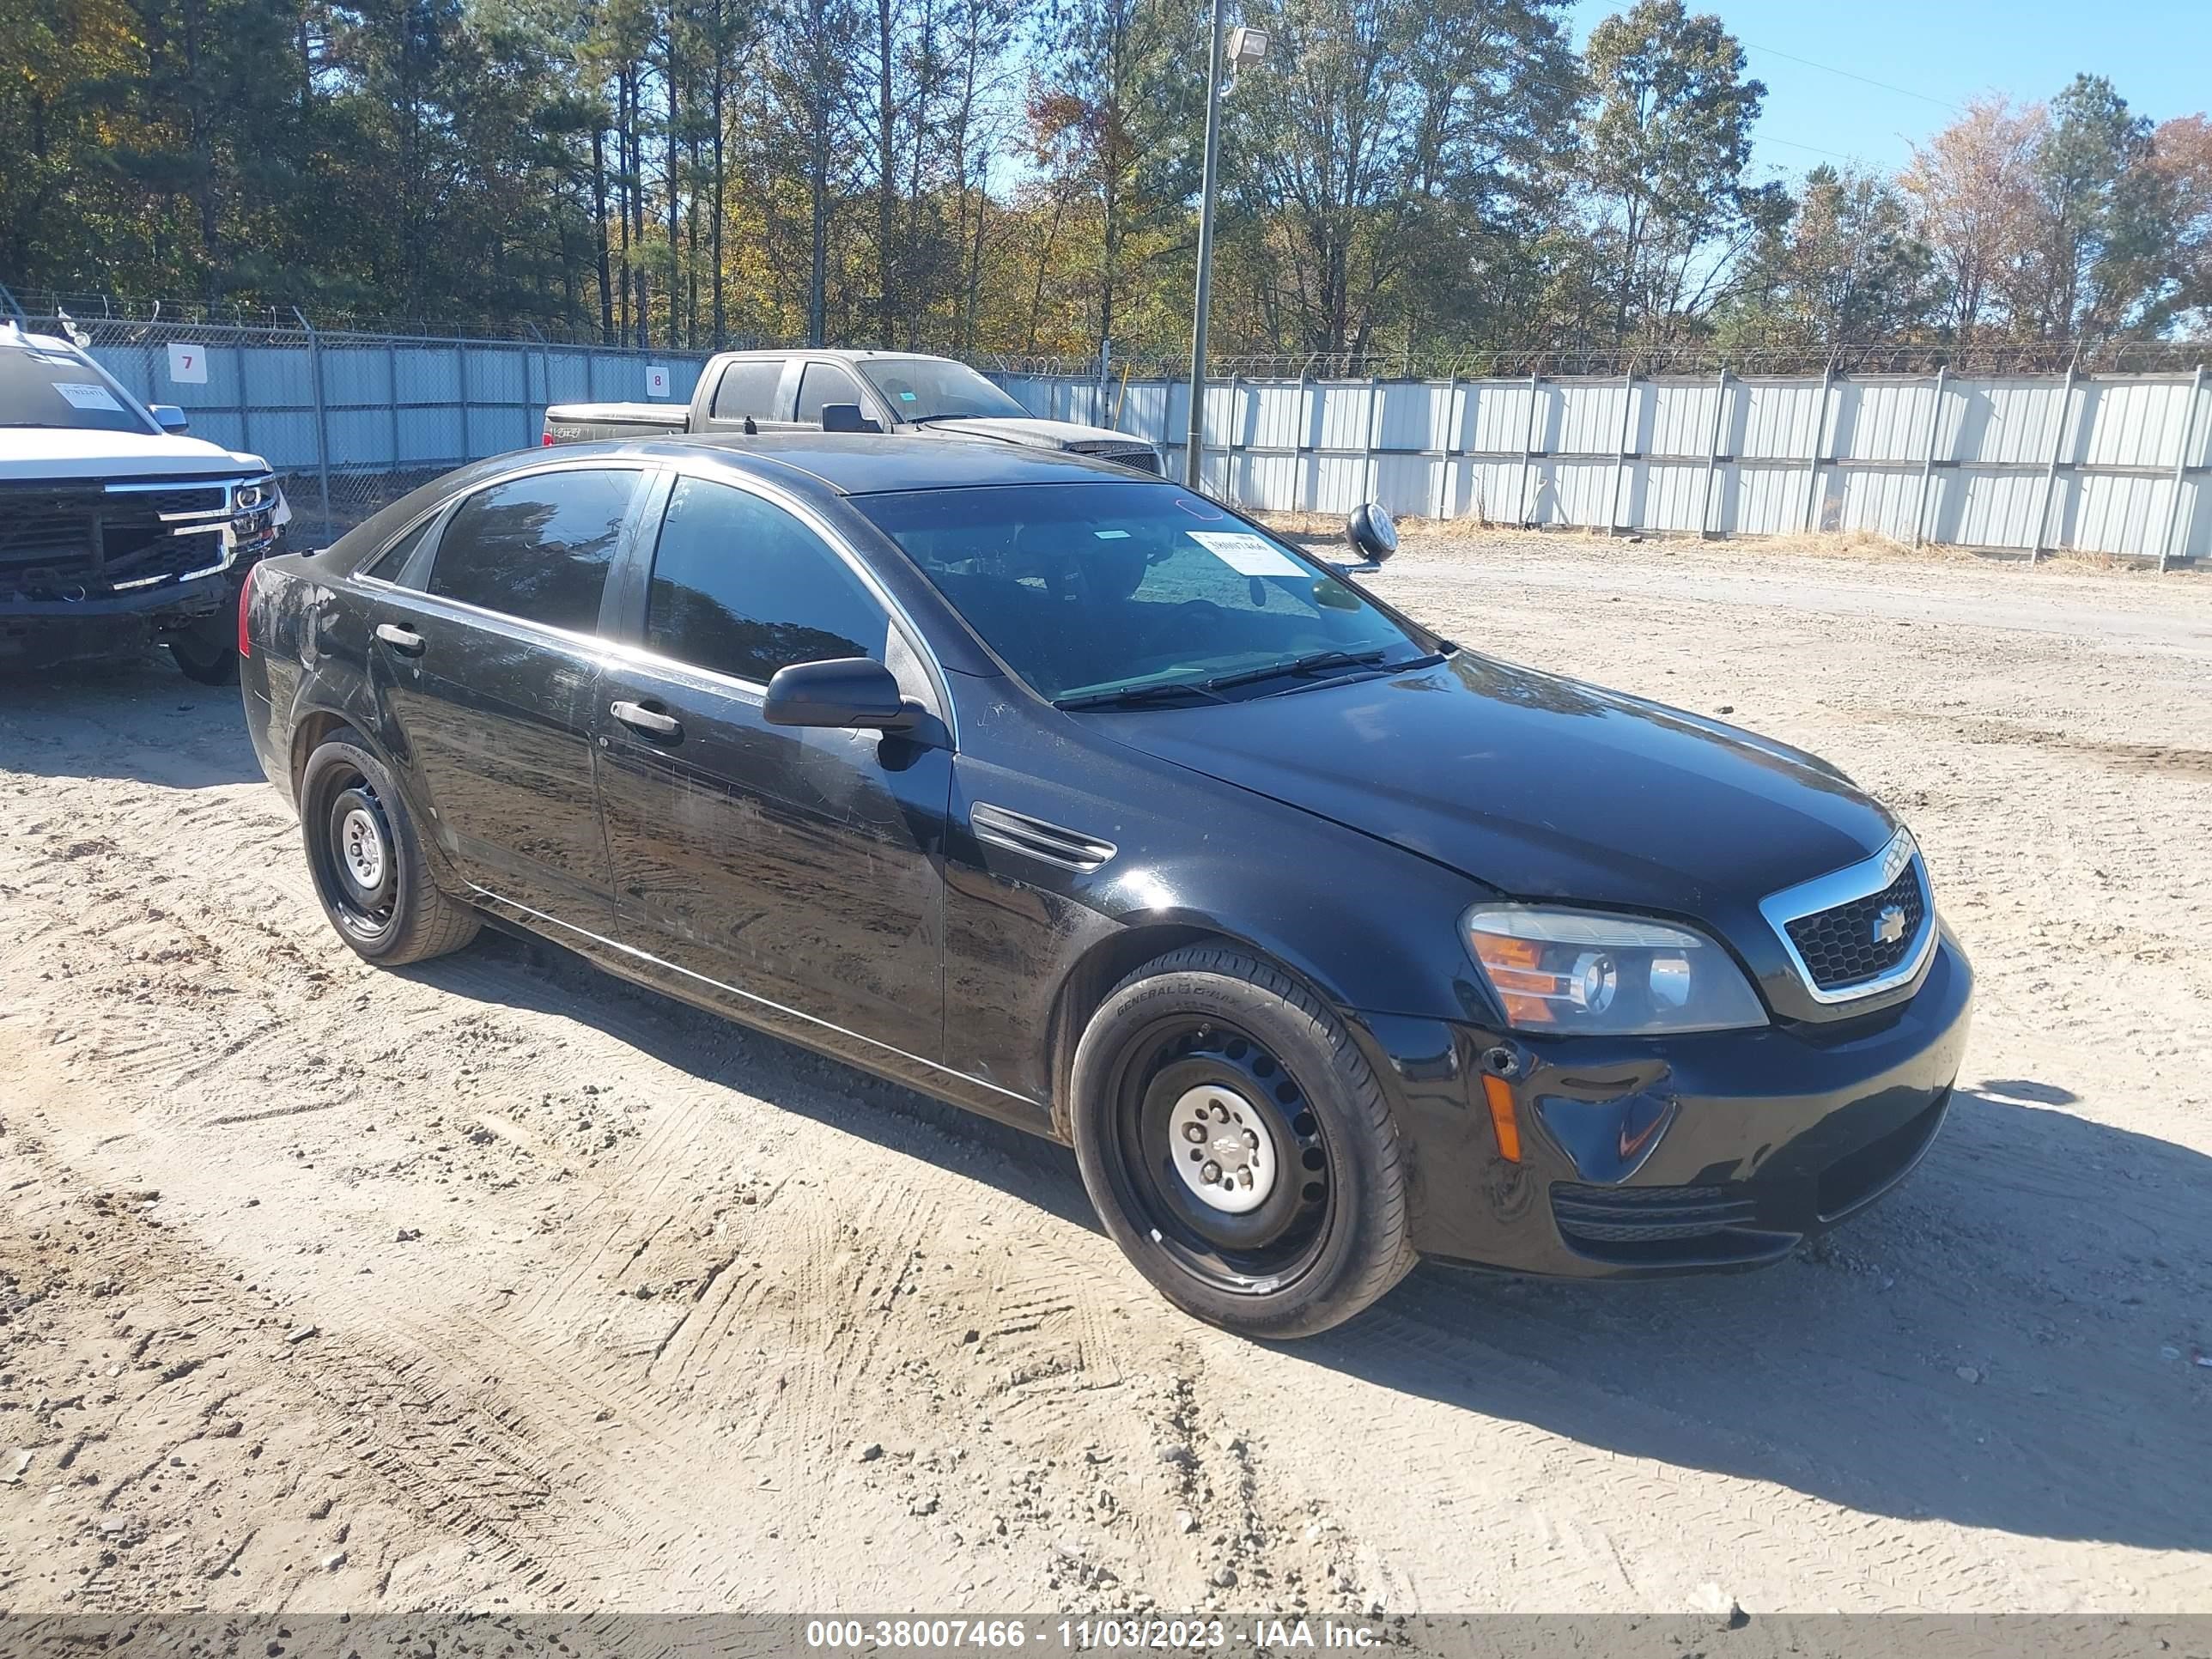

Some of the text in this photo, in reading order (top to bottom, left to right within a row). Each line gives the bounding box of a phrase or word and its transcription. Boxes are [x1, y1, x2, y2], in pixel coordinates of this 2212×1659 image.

[181, 356, 192, 369] 7
[654, 375, 661, 386] 8
[1116, 986, 1176, 1018] GENERAL
